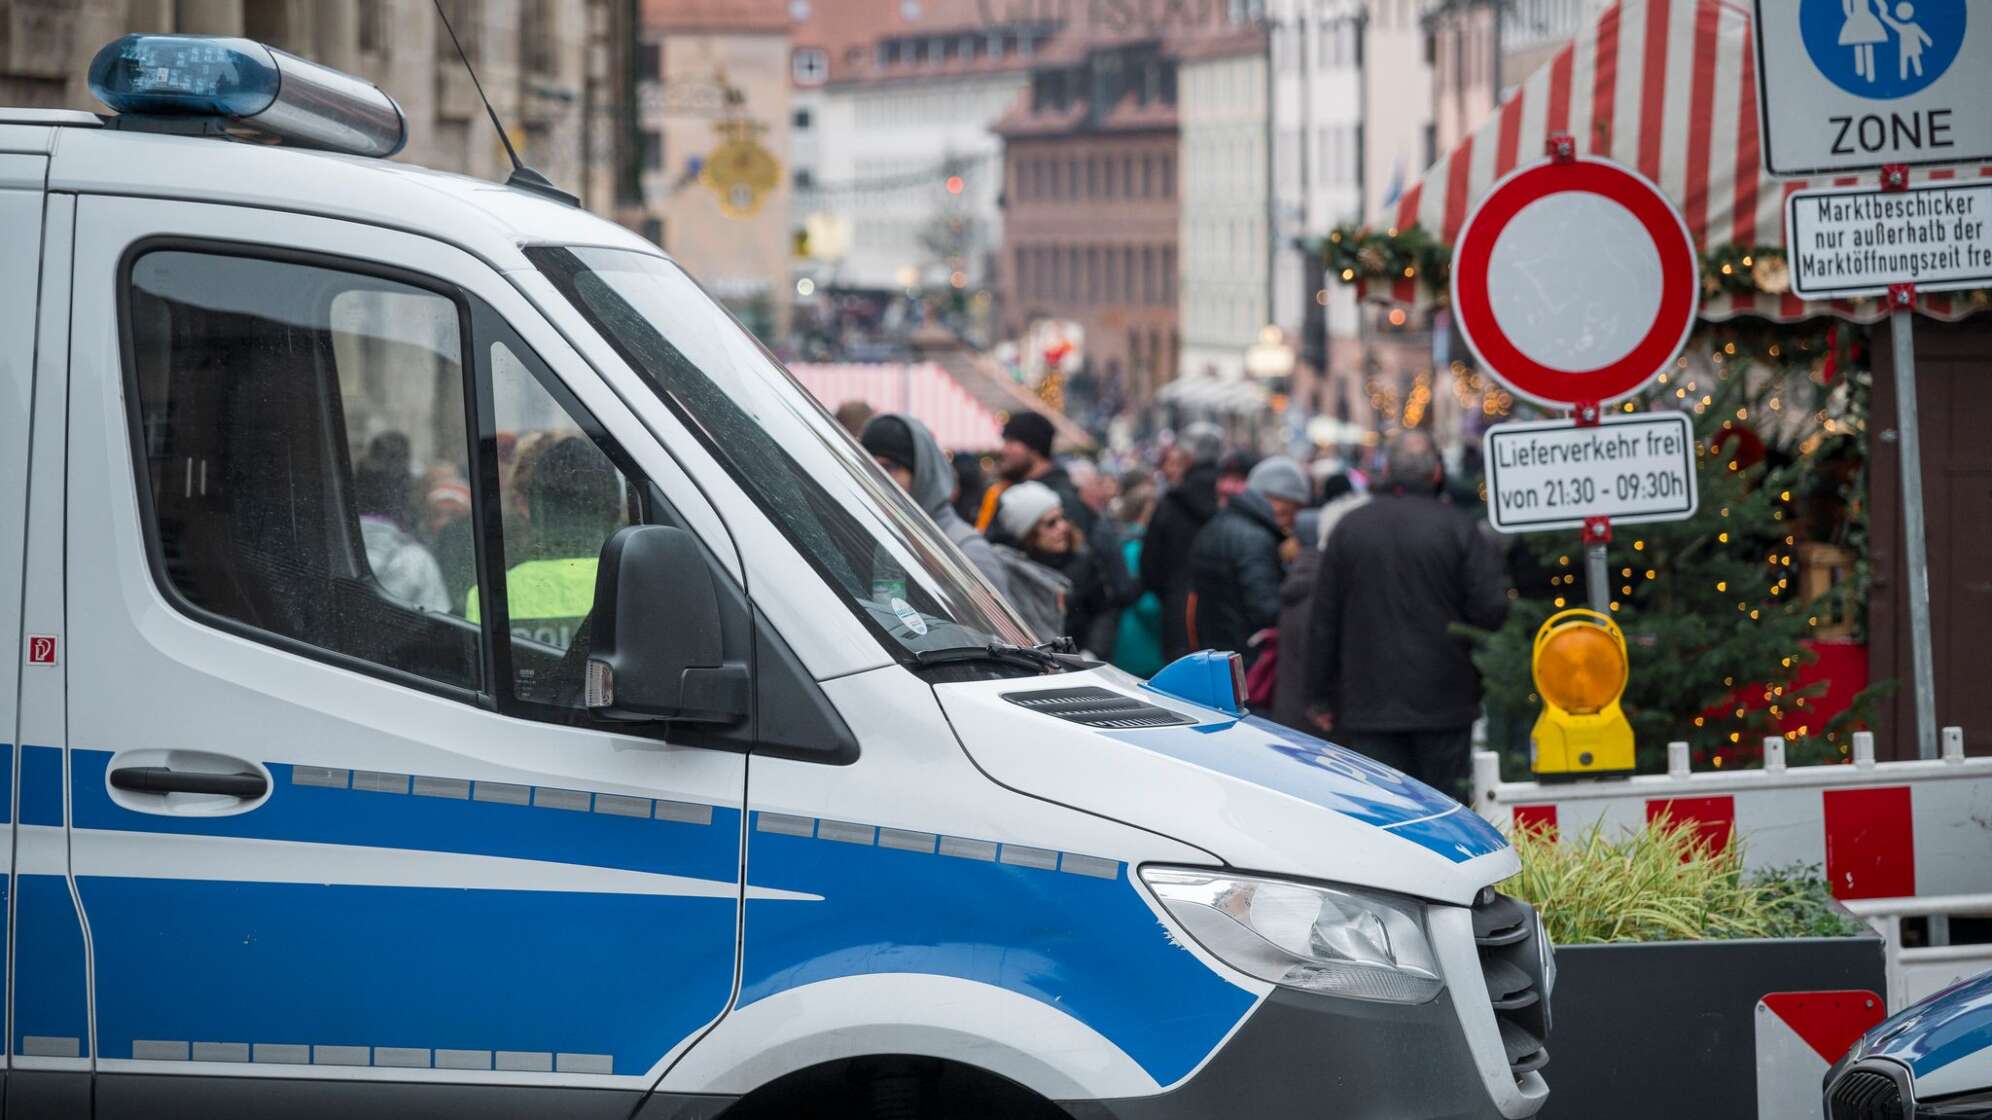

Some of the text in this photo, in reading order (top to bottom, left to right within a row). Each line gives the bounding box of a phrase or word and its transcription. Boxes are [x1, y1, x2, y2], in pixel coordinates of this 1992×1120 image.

[1828, 109, 1954, 154] ZONE
[1818, 192, 1974, 223] Marktbeschicker
[1815, 217, 1983, 249] nur außerhalb der
[1803, 245, 1960, 277] Marktöffnungszeit
[1500, 428, 1681, 468] Lieferverkehr frei
[1501, 487, 1538, 509] von
[1544, 477, 1594, 507] 21:30
[1616, 471, 1683, 501] 09:30h
